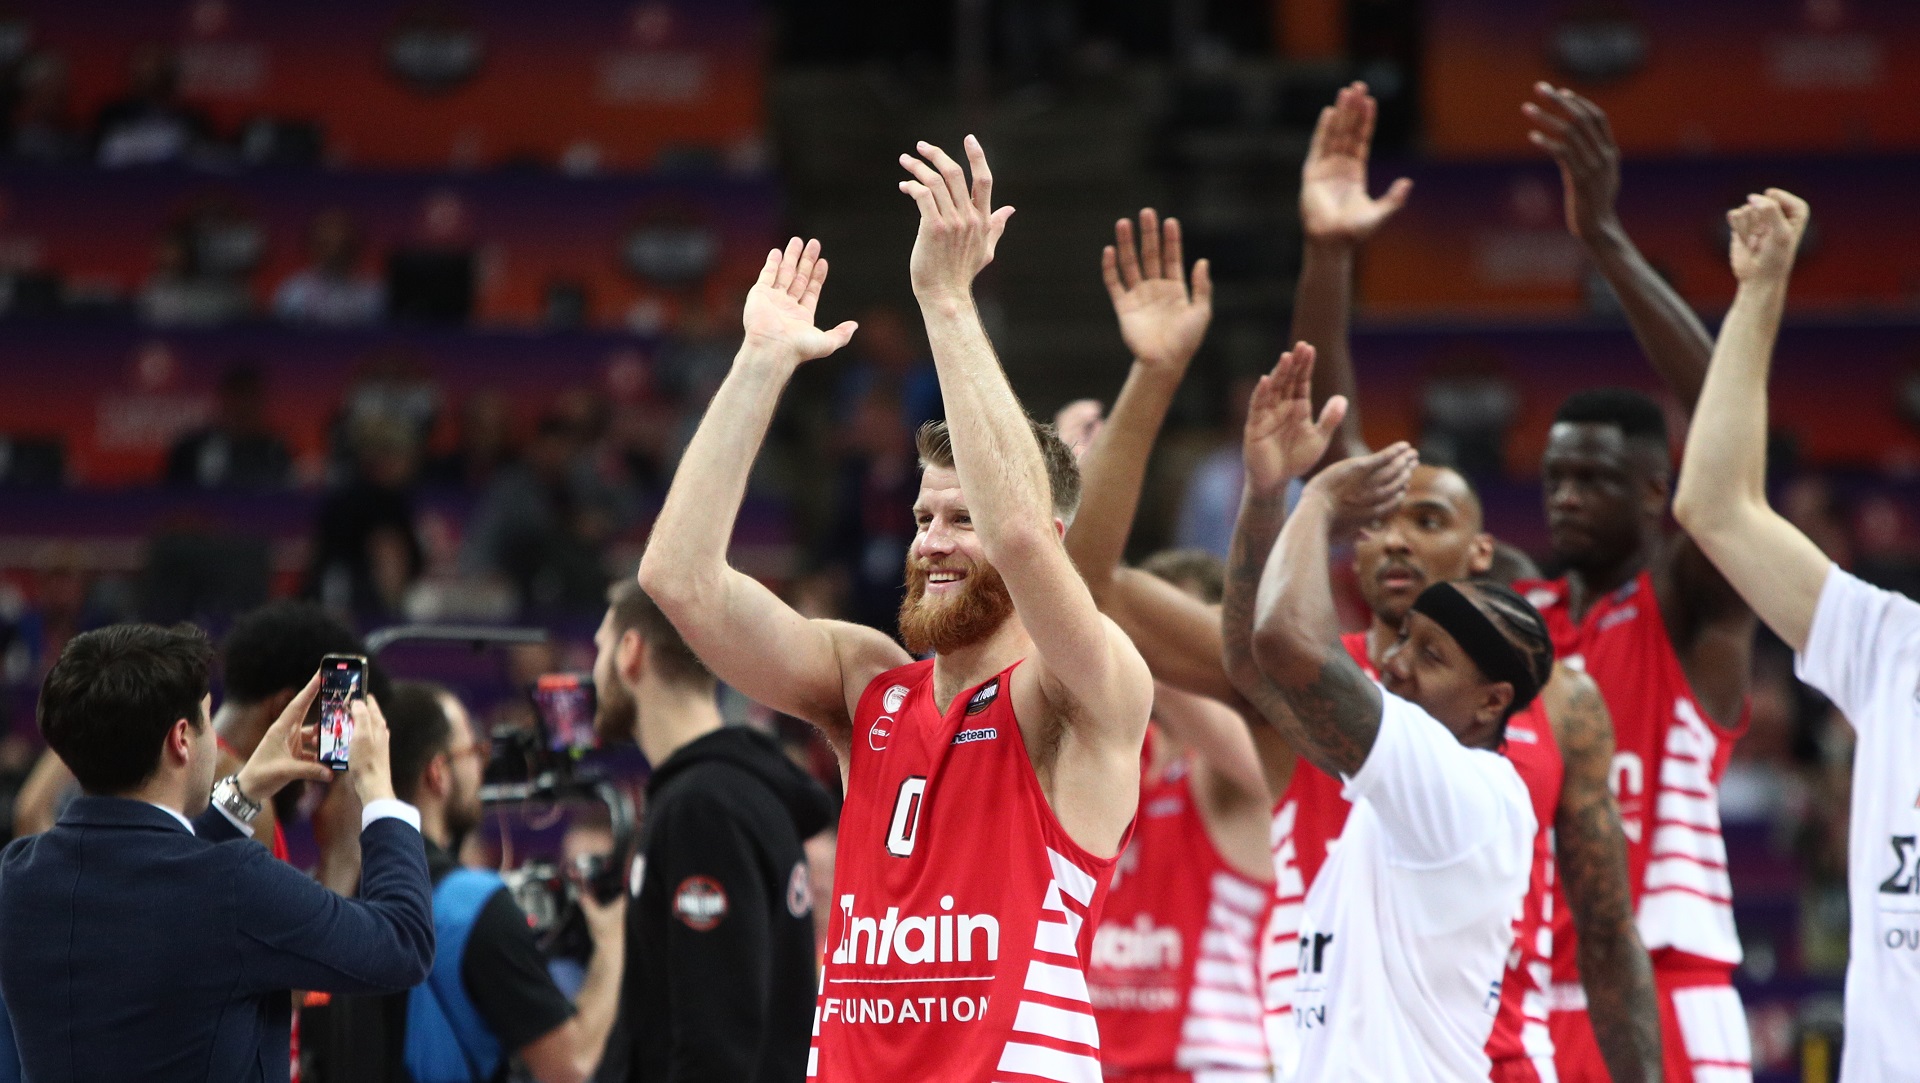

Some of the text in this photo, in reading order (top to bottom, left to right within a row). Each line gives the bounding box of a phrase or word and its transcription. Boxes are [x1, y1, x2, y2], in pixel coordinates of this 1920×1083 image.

[951, 729, 996, 744] neteam
[884, 774, 927, 858] 0
[832, 894, 999, 965] Entain
[822, 995, 990, 1024] FUNDATION
